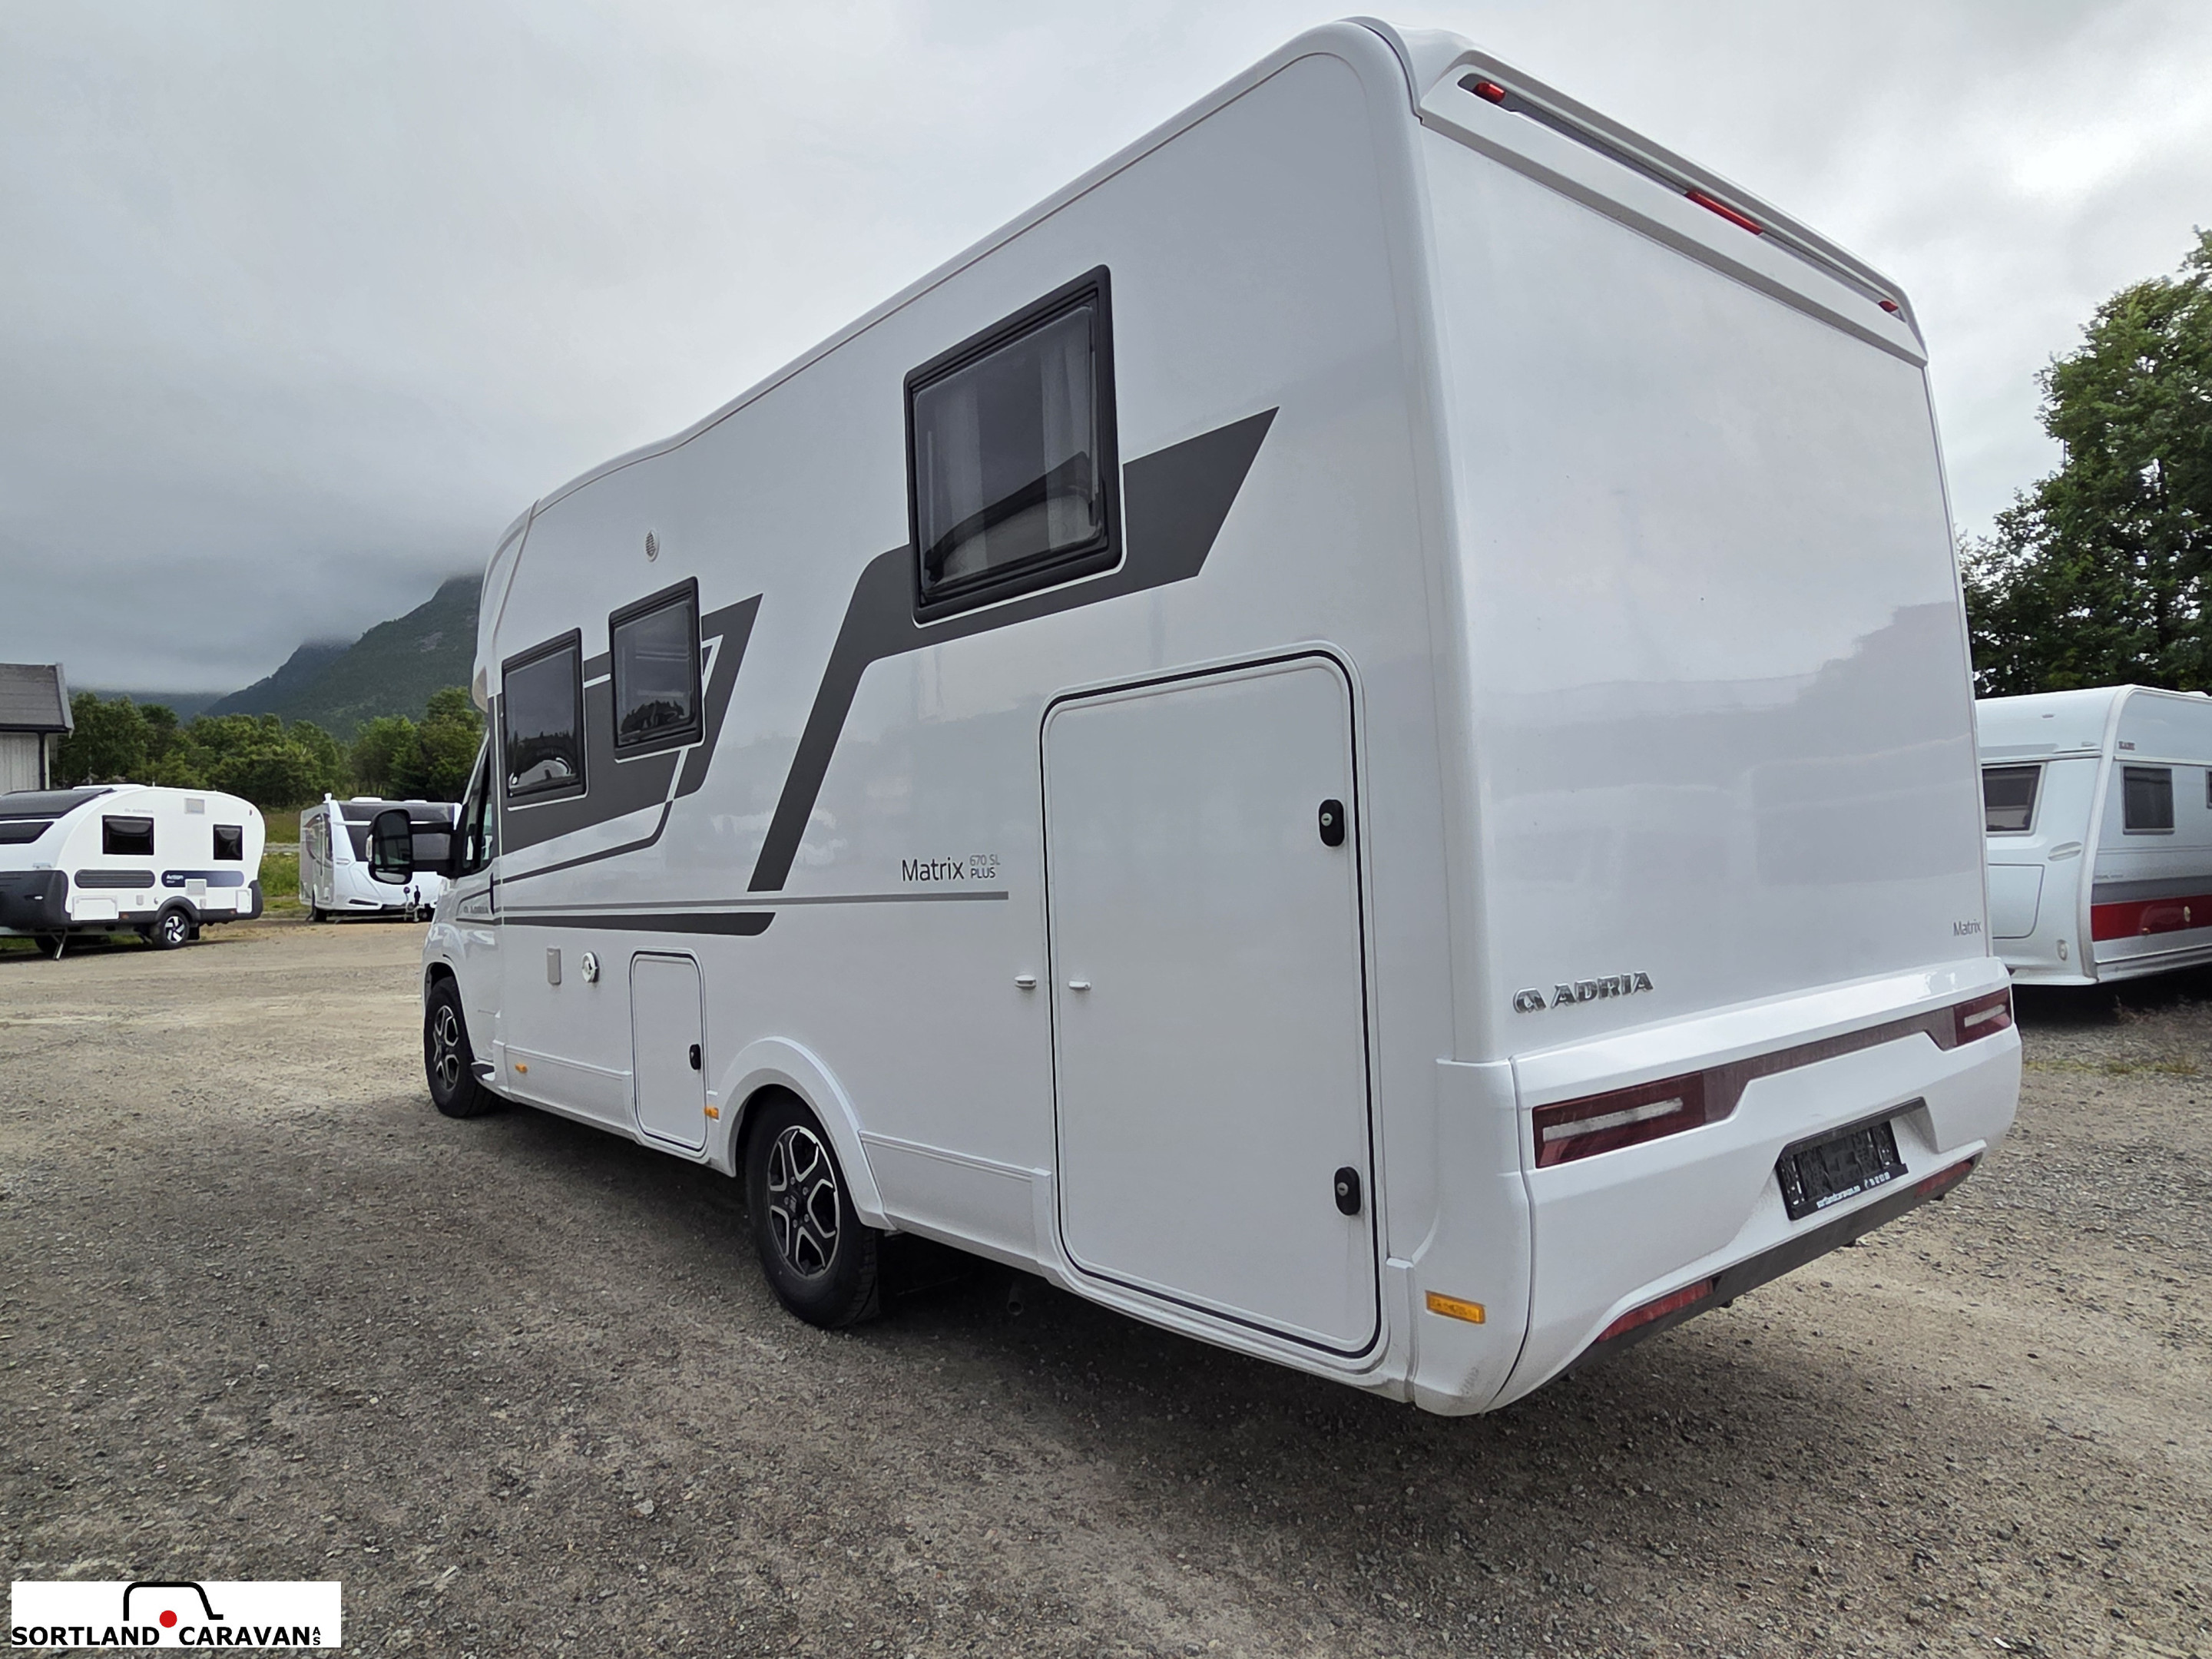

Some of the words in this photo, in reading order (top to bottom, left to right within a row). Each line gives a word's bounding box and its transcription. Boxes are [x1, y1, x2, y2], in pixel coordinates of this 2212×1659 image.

[969, 854, 987, 866] 670
[989, 853, 1001, 866] SL
[902, 856, 965, 882] Matrix
[970, 866, 996, 879] PLUS
[1953, 919, 1982, 936] Matrix
[1550, 971, 1654, 1009] ADRIA
